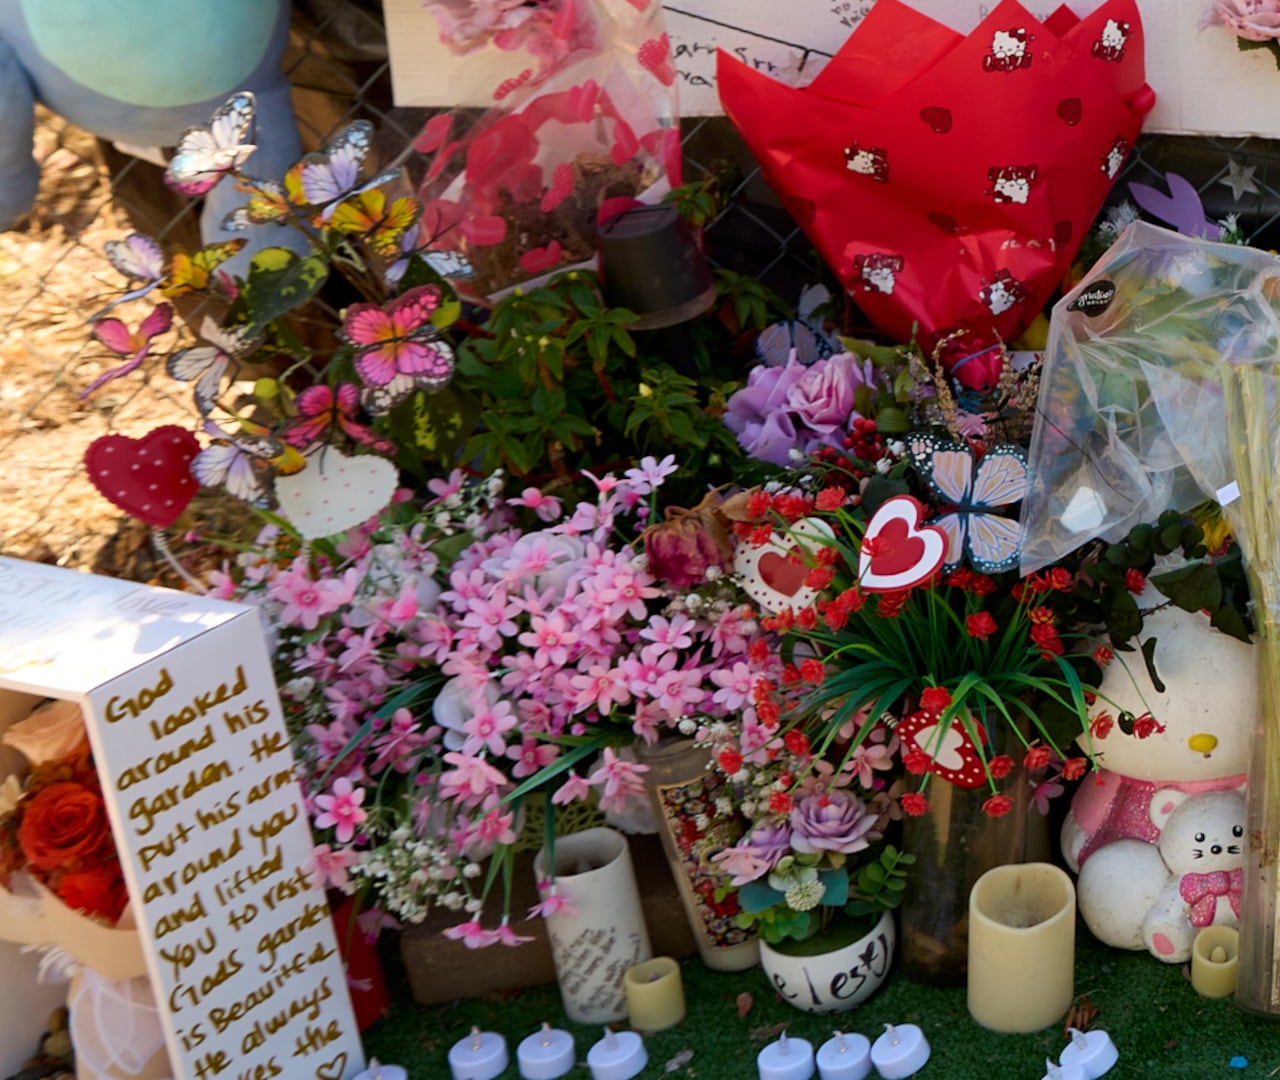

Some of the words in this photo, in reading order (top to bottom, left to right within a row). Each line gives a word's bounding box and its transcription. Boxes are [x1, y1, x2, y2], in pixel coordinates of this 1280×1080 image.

[104, 667, 174, 724] God
[149, 665, 248, 741] looked
[116, 724, 216, 791] around
[223, 699, 270, 735] his
[195, 790, 241, 831] his
[142, 828, 244, 904] around
[154, 891, 208, 940] and
[228, 903, 258, 932] to
[241, 976, 333, 1055] always
[291, 1019, 344, 1058] the
